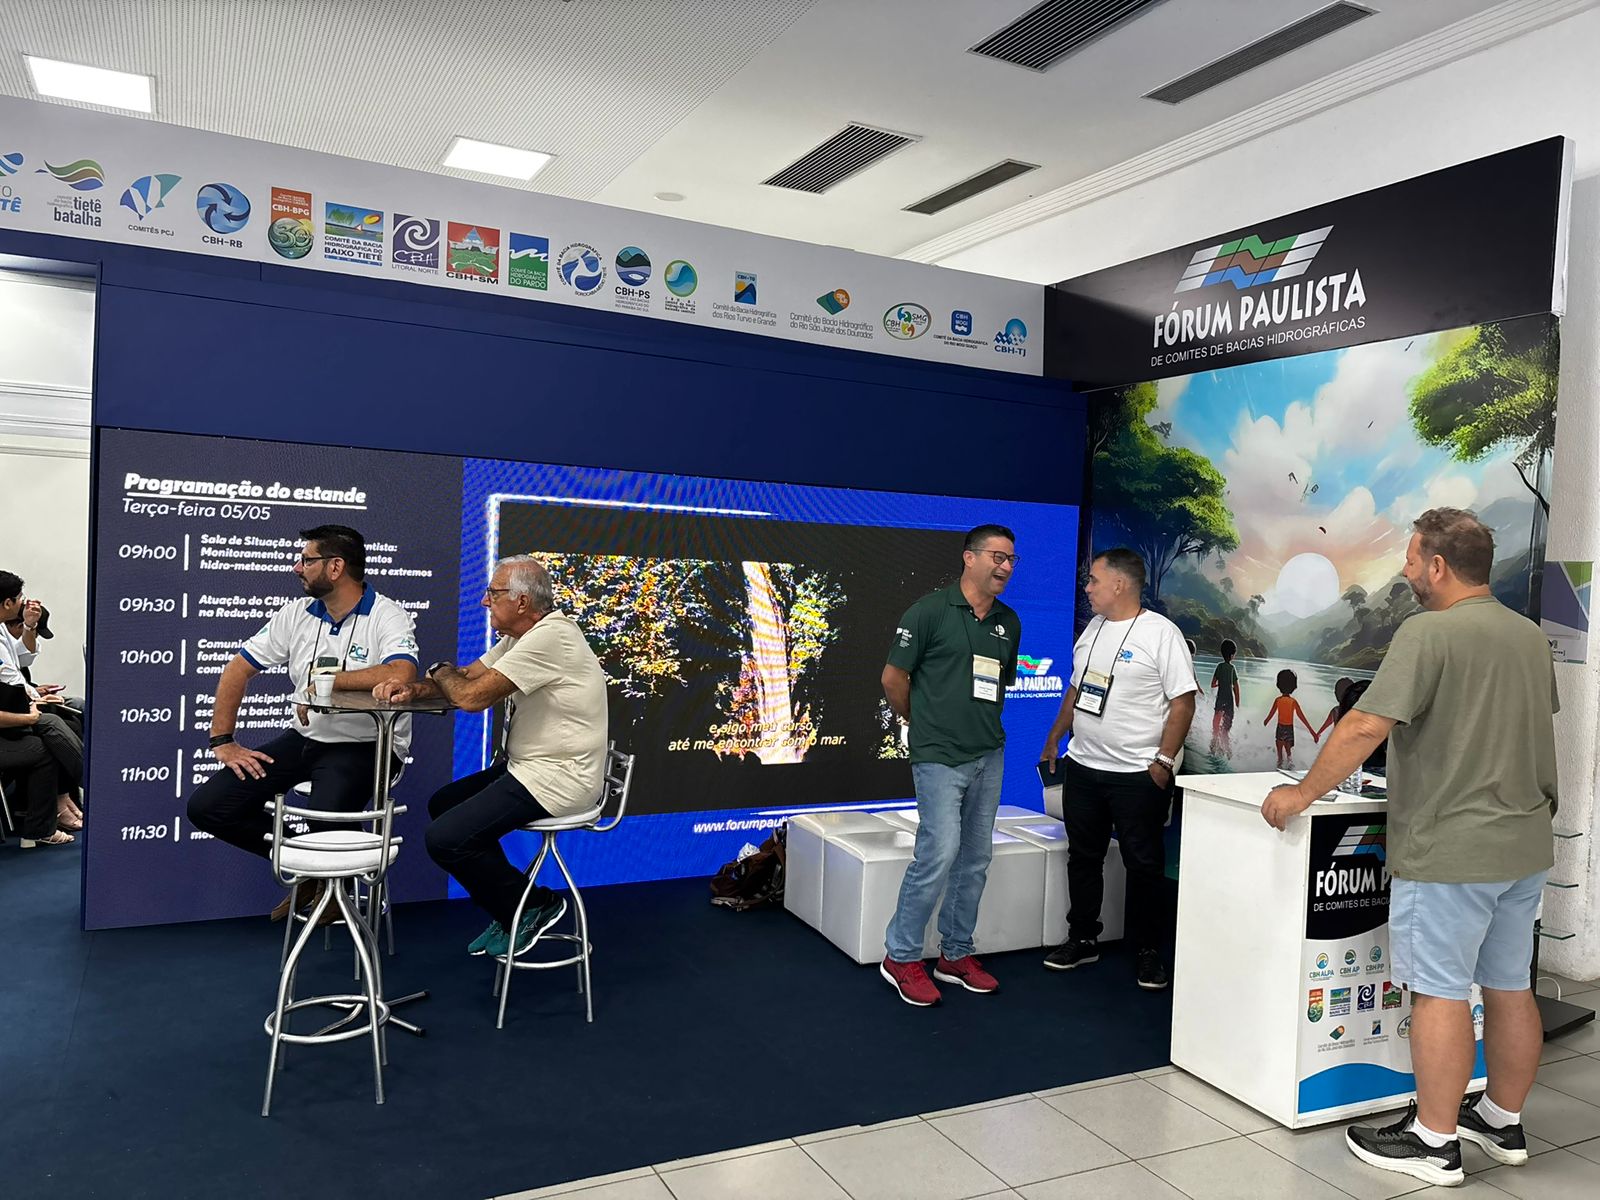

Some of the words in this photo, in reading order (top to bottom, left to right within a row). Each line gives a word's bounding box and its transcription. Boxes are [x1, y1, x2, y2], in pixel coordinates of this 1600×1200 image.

[0, 197, 21, 213] TÊ
[73, 196, 102, 213] tietê
[272, 203, 310, 216] CBH-BPG
[54, 207, 102, 227] batalha
[128, 224, 159, 236] COMITÊS
[161, 229, 175, 237] PCJ
[202, 235, 243, 249] CBH-RB
[324, 246, 355, 257] BAIXO
[392, 264, 417, 273] LITORAL
[418, 267, 439, 275] NORTE
[446, 271, 499, 285] CBH-SM
[510, 277, 521, 285] DO
[523, 279, 546, 289] PARDO
[615, 286, 650, 299] CBH-PS
[712, 302, 729, 312] Comitê
[736, 306, 749, 314] Bacia
[1153, 301, 1233, 349] FÓRUM
[1239, 267, 1367, 332] PAULISTA
[712, 310, 723, 319] dos
[724, 311, 736, 320] Rios
[736, 313, 752, 323] Turvo
[757, 316, 777, 326] Grande
[790, 312, 812, 322] Comitê
[885, 319, 901, 327] CBH
[912, 313, 927, 322] SMG
[799, 322, 808, 331] Rio
[809, 323, 820, 332] São
[821, 325, 835, 335] José
[836, 327, 846, 336] dos
[847, 328, 873, 340] Dourados
[1150, 353, 1163, 367] DE
[1165, 346, 1208, 364] COMITES
[1210, 343, 1224, 356] DE
[1226, 336, 1264, 353] BACIAS
[1266, 316, 1366, 346] HIDROGRÁFICAS
[994, 345, 1026, 357] CBH-TJ
[124, 472, 263, 499] Programação
[266, 481, 291, 499] do
[293, 486, 367, 503] estande
[122, 498, 216, 518] Terça-feira
[220, 504, 271, 520] 05/05
[201, 533, 227, 545] Sala
[228, 535, 242, 545] de
[244, 536, 292, 549] Situação
[364, 542, 398, 552] ntista:
[118, 544, 177, 560] 09h00
[200, 547, 285, 560] Monitoramento
[286, 552, 293, 560] e
[294, 552, 303, 562] p
[365, 555, 393, 564] entos
[200, 559, 293, 573] hidro-meteocean
[364, 567, 379, 575] ros
[380, 568, 387, 576] e
[388, 567, 433, 577] extremos
[119, 597, 175, 612] 09h30
[198, 594, 247, 607] Atuação
[248, 596, 263, 606] do
[264, 596, 297, 606] CBH-
[395, 599, 430, 610] iental
[198, 609, 214, 617] na
[215, 607, 263, 620] Redução
[197, 638, 245, 649] Comuni
[120, 649, 173, 664] 10h00
[197, 651, 236, 661] fortale
[349, 645, 369, 659] PCJ
[196, 665, 225, 674] comi
[1024, 676, 1063, 691] PAULISTA
[195, 694, 216, 704] Pla
[242, 693, 285, 705] unicipal
[120, 708, 172, 723] 10h30
[194, 708, 214, 717] esc
[249, 706, 282, 716] bacia:
[194, 720, 213, 731] aç
[246, 718, 291, 730] municíp
[709, 723, 718, 733] e
[720, 722, 747, 736] sigo
[750, 721, 777, 733] meu
[668, 737, 690, 751] até
[693, 738, 714, 750] me
[716, 736, 777, 750] encontrar
[780, 736, 806, 748] com
[809, 736, 818, 746] o
[820, 734, 847, 746] mar.
[193, 748, 203, 759] A
[204, 748, 216, 759] in
[192, 760, 225, 772] comi
[121, 766, 170, 782] 11h00
[694, 816, 788, 833] www.forumpaul
[121, 824, 168, 840] 11h30
[190, 831, 215, 840] mo
[1316, 861, 1376, 897] FÓRUM
[1380, 866, 1390, 891] P
[1313, 903, 1324, 912] DE
[1325, 899, 1359, 911] COMITES
[1360, 898, 1370, 907] DE
[1371, 896, 1390, 906] BACI
[1309, 971, 1320, 979] CBH
[1320, 969, 1335, 978] ALPA
